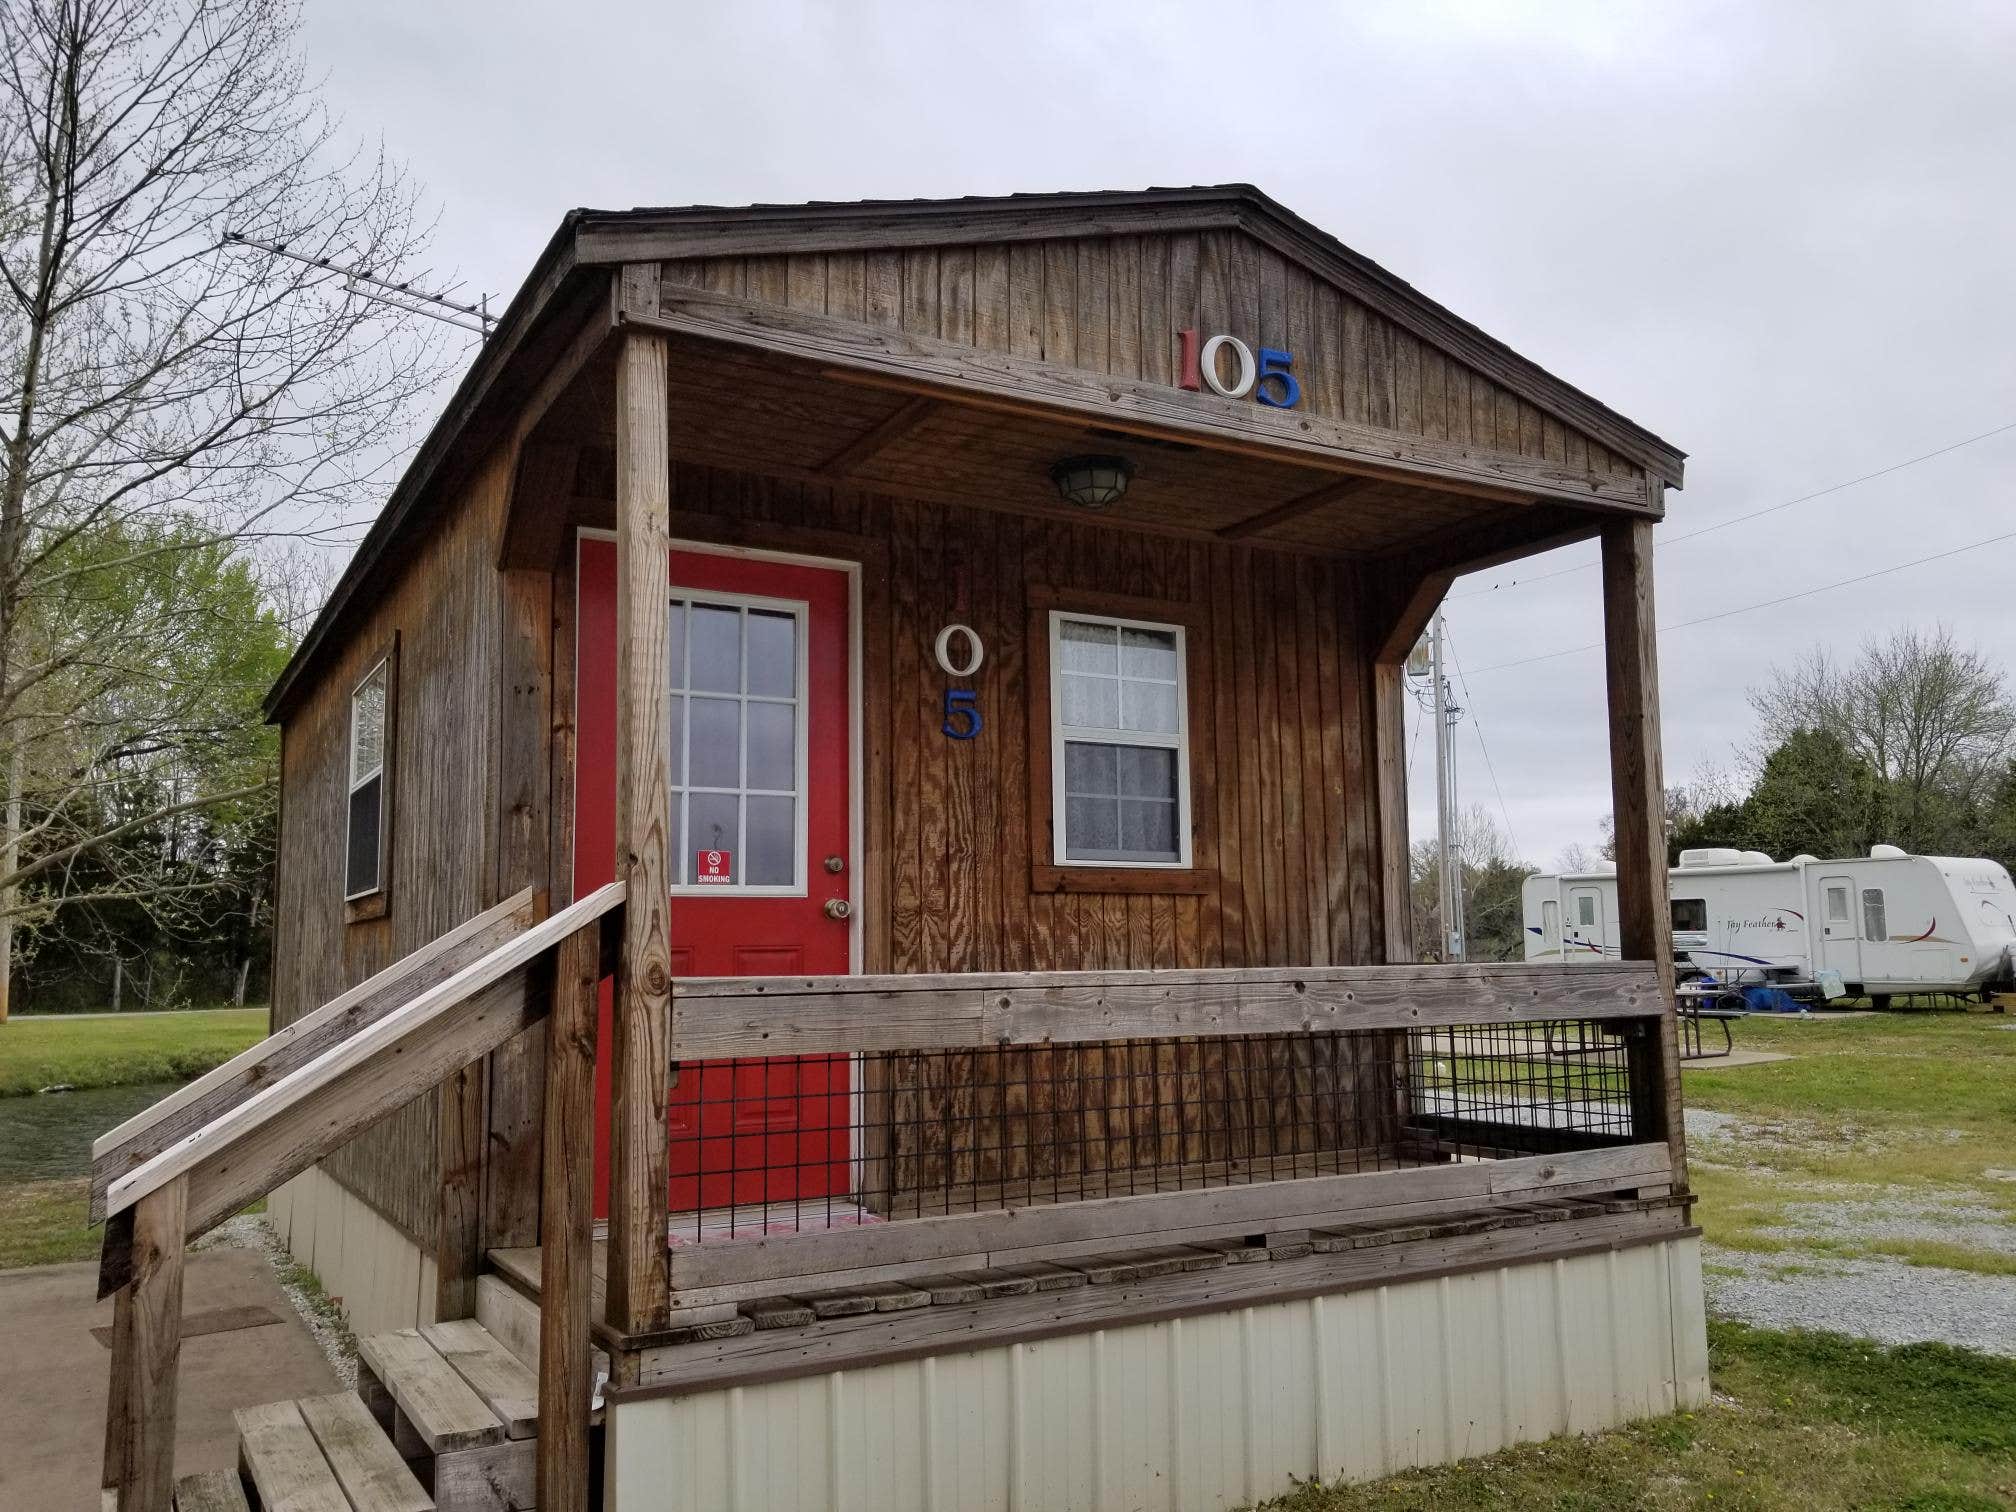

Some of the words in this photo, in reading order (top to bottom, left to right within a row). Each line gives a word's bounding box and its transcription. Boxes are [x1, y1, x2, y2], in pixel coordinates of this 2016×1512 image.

[1177, 329, 1300, 408] 105
[709, 866, 720, 874] NO
[698, 874, 730, 883] SMOKING
[1727, 920, 1741, 934] Jay
[1743, 915, 1776, 928] Feather
